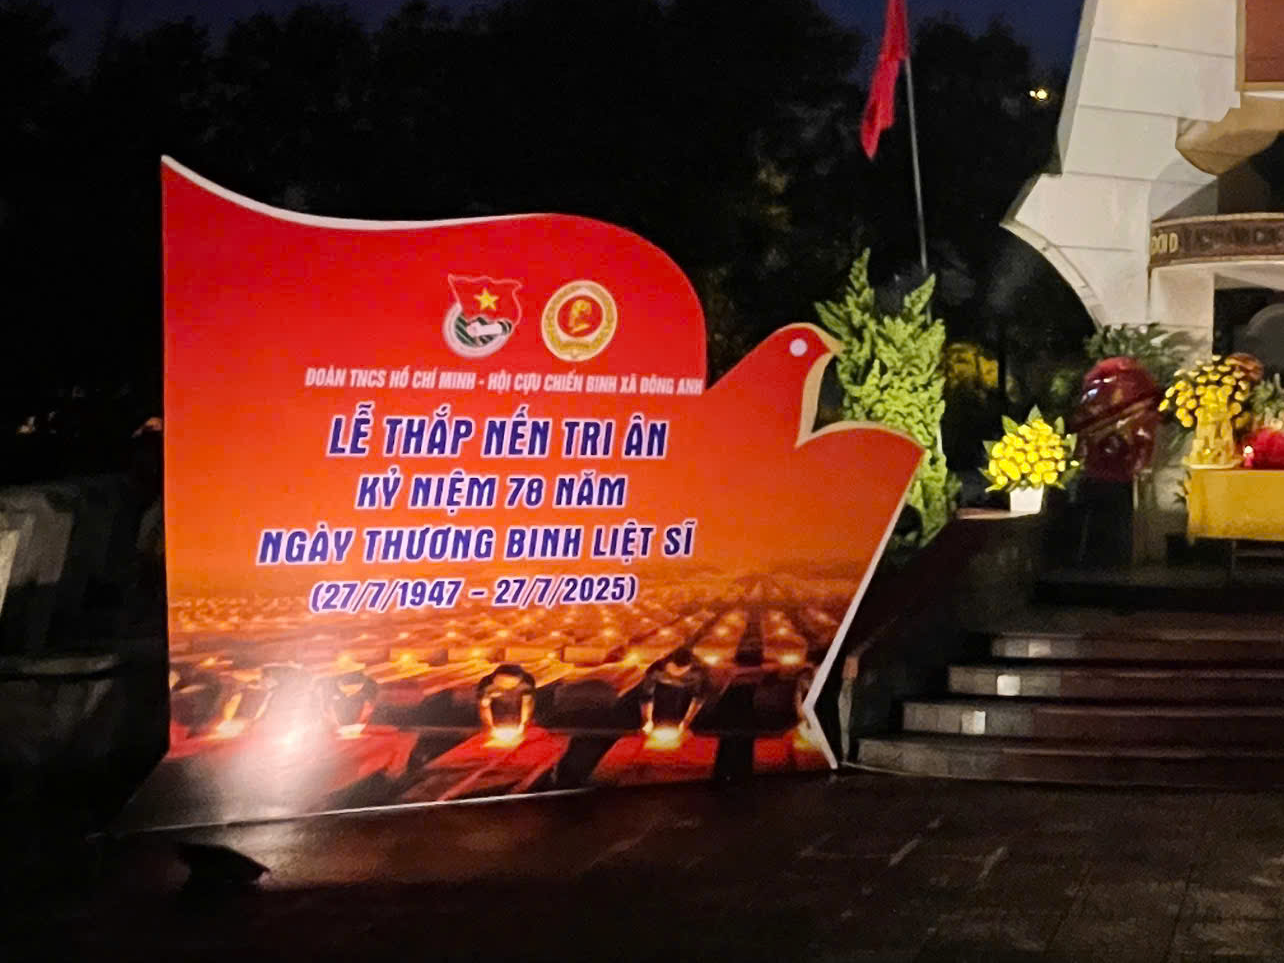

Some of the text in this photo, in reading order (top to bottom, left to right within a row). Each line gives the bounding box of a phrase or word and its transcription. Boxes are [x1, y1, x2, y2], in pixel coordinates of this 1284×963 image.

[305, 365, 347, 387] ĐOÀN
[350, 368, 386, 388] TNCS
[389, 365, 411, 388] HỒ
[412, 366, 438, 388] CHÍ
[438, 372, 477, 390] MINH
[487, 368, 512, 395] HỘI
[514, 372, 542, 395] CỰU
[543, 368, 584, 392] CHIẾN
[585, 374, 618, 393] BINH
[619, 372, 637, 394] XÃ
[639, 374, 674, 395] ĐÔNG
[676, 377, 704, 396] ANH
[326, 401, 669, 460] LỄ THẮP NẾN TRI ÂN
[355, 465, 628, 515] KỶ NIỆM 78 NĂM
[256, 518, 698, 565] NGÀY THƯƠNG BINH LIỆT SĨ
[309, 577, 464, 613] (27/7/1947
[492, 574, 638, 609] 27/7/2025)
